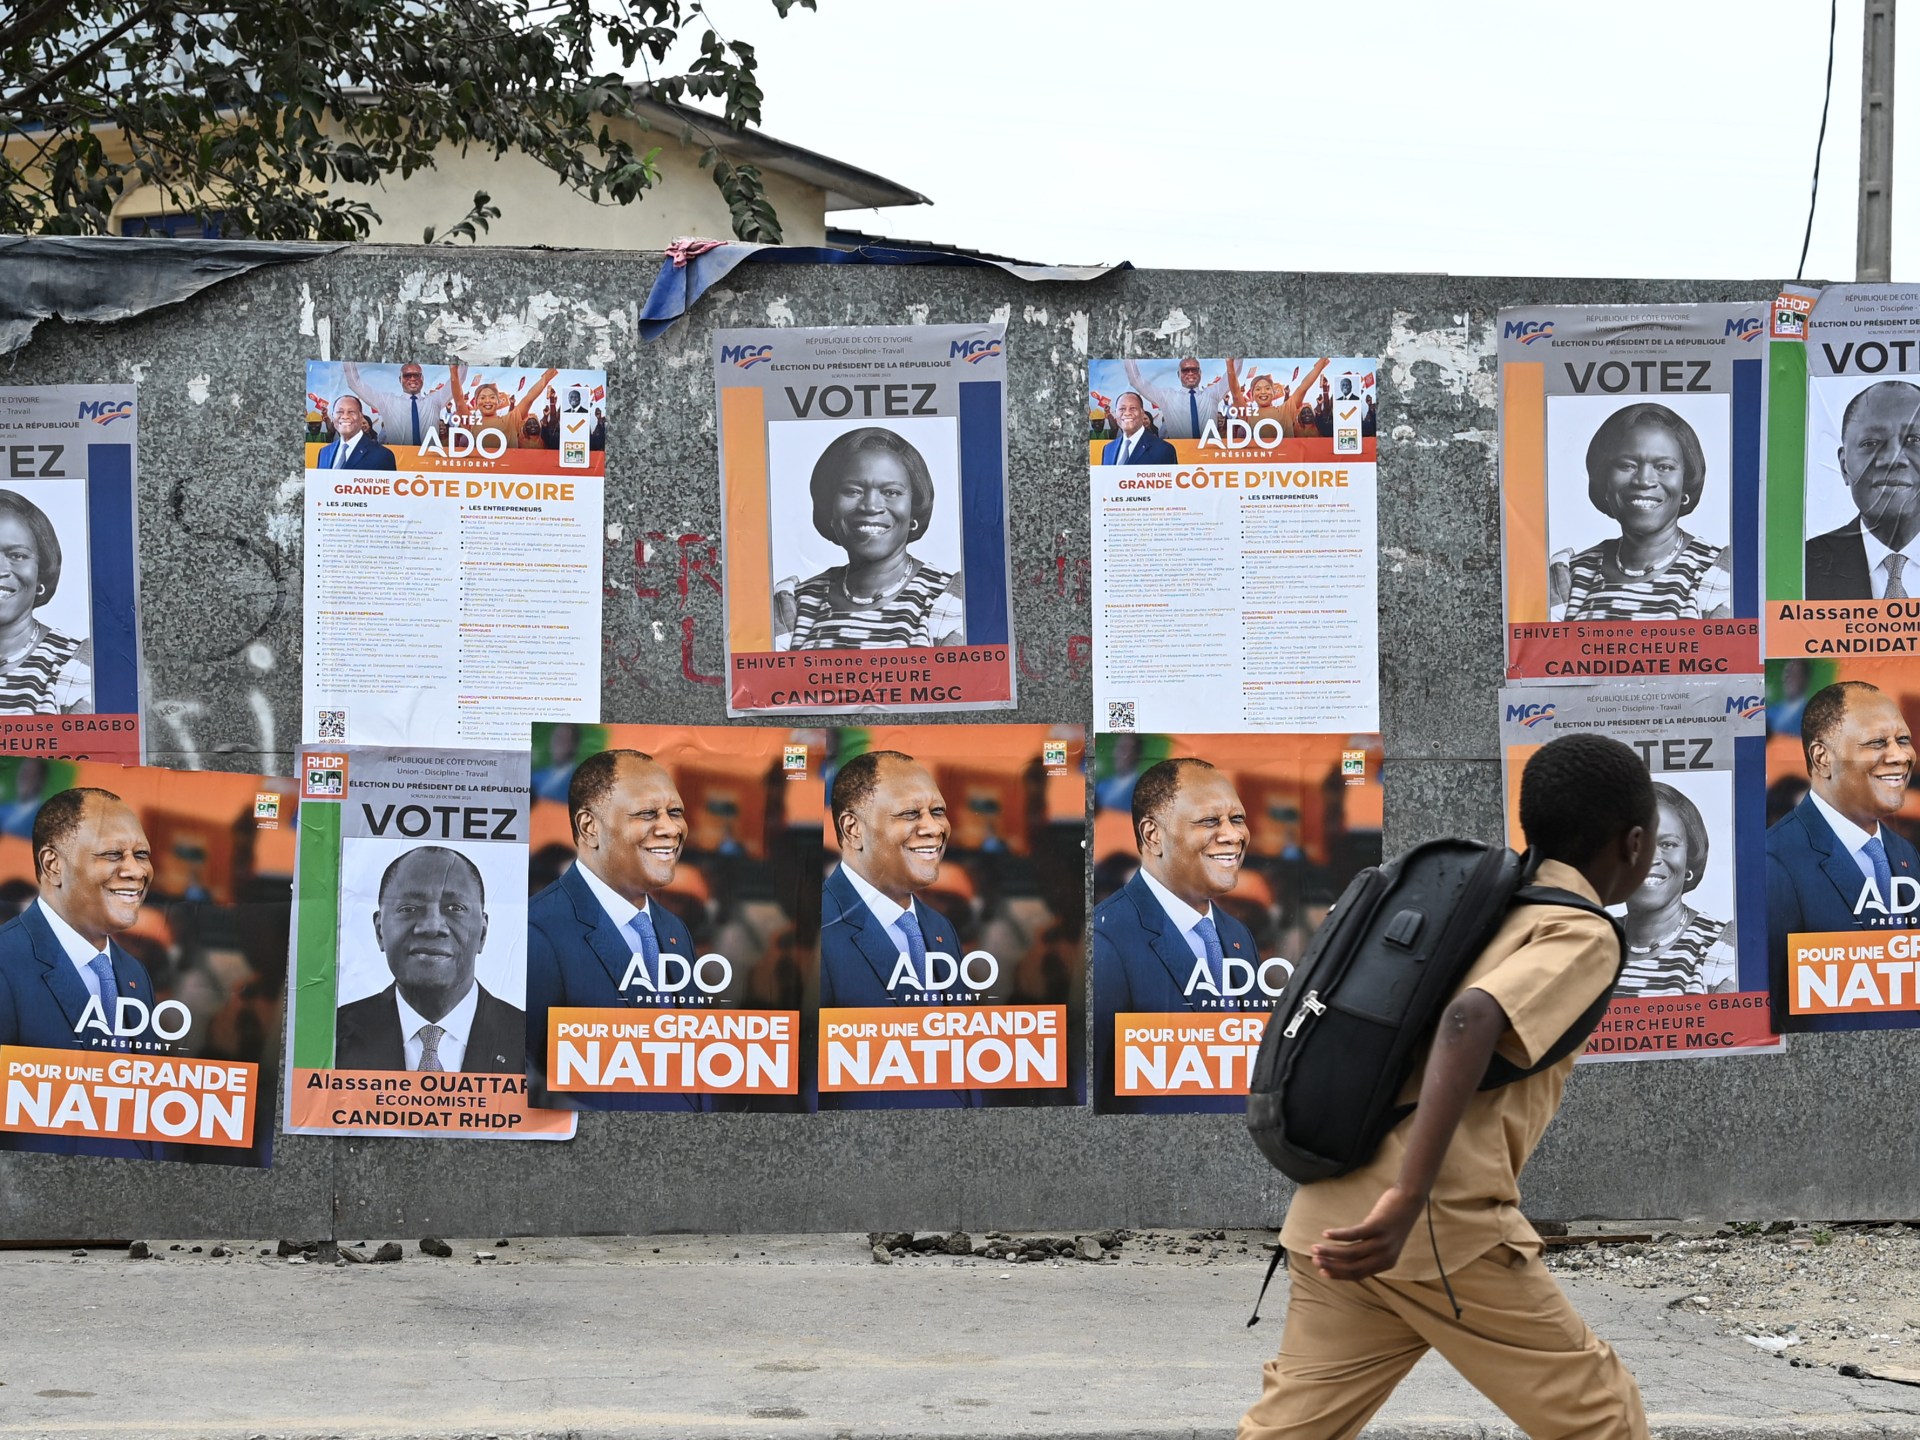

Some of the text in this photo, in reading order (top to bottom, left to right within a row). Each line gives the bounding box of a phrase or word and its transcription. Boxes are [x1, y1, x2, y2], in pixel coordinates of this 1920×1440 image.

[1776, 297, 1810, 311] RHDP
[1845, 294, 1889, 302] RÉPUBLIQUE
[1900, 293, 1919, 301] CÔTE
[1881, 305, 1913, 313] Discipline
[1504, 321, 1554, 339] MGC
[1724, 318, 1763, 336] MG
[1809, 320, 1848, 328] ÉLECTION
[1864, 318, 1908, 327] PRÉSIDENT
[805, 334, 913, 345] RÉPUBLIQUE DE CÔTE D'IVOIRE
[1551, 340, 1590, 348] ÉLECTION
[1606, 338, 1650, 347] PRÉSIDENT
[1676, 337, 1726, 345] RÉPUBLIQUE
[720, 344, 773, 363] MGC
[815, 347, 905, 357] Union Discipline Travail
[950, 339, 1002, 359] MGC
[1822, 341, 1920, 374] VOT
[770, 361, 810, 371] ÉLECTION
[813, 363, 825, 371] DU
[827, 361, 871, 370] PRÉSIDENT
[899, 359, 951, 369] RÉPUBLIQUE
[1564, 360, 1712, 393] VOTEZ
[784, 383, 938, 418] VOTEZ
[78, 401, 133, 419] MGC
[25, 421, 80, 430] RÉPUBLIQUE
[1198, 418, 1283, 450] ADO
[417, 426, 507, 460] ADO
[1214, 450, 1273, 458] PRÉSIDENT
[435, 459, 496, 468] PRÉSIDENT
[1118, 467, 1349, 490] GRANDE CÔTE D'IVOIRE
[334, 475, 575, 501] GRANDE CÔTE D'IVOIRE
[1779, 604, 1878, 621] Alassane
[1514, 624, 1758, 640] EHIVET Simone épouse GBAGB
[1845, 621, 1920, 634] ÉCONOMI
[1581, 641, 1699, 655] CHERCHEURE
[1805, 637, 1918, 653] CANDIDAT
[736, 650, 1006, 670] EHIVET Simone épouse GBAGBO
[1545, 658, 1729, 676] CANDIDATE MGC
[808, 669, 931, 686] CHERCHEURE
[771, 686, 962, 706] CANDIDATE MGC
[1587, 692, 1690, 703] RÉPUBLIQUE CÔTE D'IVOIRE
[1725, 695, 1766, 714] MG
[1506, 704, 1556, 722] MGC
[1622, 705, 1655, 713] Discipline
[61, 720, 135, 731] GBAGBO
[1554, 721, 1592, 729] ÉLECTION
[1607, 718, 1650, 727] PRÉSIDENT
[1676, 716, 1727, 724] RÉPUBLIQUE
[784, 746, 806, 754] RHDP
[1044, 742, 1066, 750] RHDP
[1633, 738, 1714, 770] TEZ
[307, 757, 344, 768] RHDP
[388, 756, 433, 765] RÉPUBLIQUE
[446, 757, 466, 766] CÔTE
[466, 759, 498, 767] D'IVOIRE
[425, 769, 460, 778] Discipline
[466, 770, 488, 778] Travail
[349, 780, 390, 788] ÉLECTION
[407, 781, 453, 791] PRÉSIDENT
[481, 784, 531, 794] RÉPUBLIQU
[362, 803, 518, 840] VOTEZ
[1853, 876, 1920, 915] AD
[1797, 947, 1846, 962] POUR
[1848, 945, 1884, 960] UNE
[618, 952, 733, 993] ADO
[886, 951, 999, 991] ADO
[1183, 957, 1296, 998] ADO
[637, 993, 715, 1004] PRÉSIDENT
[905, 992, 982, 1002] PRÉSIDENT
[1201, 998, 1278, 1008] PRÉSIDENT
[1647, 1000, 1702, 1015] épouse
[74, 994, 192, 1040] ADO
[827, 1011, 1057, 1038] POUR UNE GRANDE
[1592, 1016, 1705, 1033] HERCHEURE
[557, 1015, 789, 1040] POUR UNE GRANDE
[1124, 1028, 1174, 1043] POUR
[1178, 1027, 1215, 1042] UNE
[92, 1037, 172, 1051] PRÉSIDENT
[1585, 1032, 1735, 1053] NDIDATE MGC
[556, 1040, 789, 1088] NATION
[828, 1038, 1057, 1085] NATION
[1124, 1045, 1260, 1089] NATI
[9, 1058, 248, 1093] POUR UNE GRANDE
[307, 1073, 412, 1091] Alassane
[375, 1091, 487, 1108] ÉCONOMISTE
[4, 1079, 247, 1141] NATION
[332, 1110, 522, 1129] CANDIDAT RHDP
